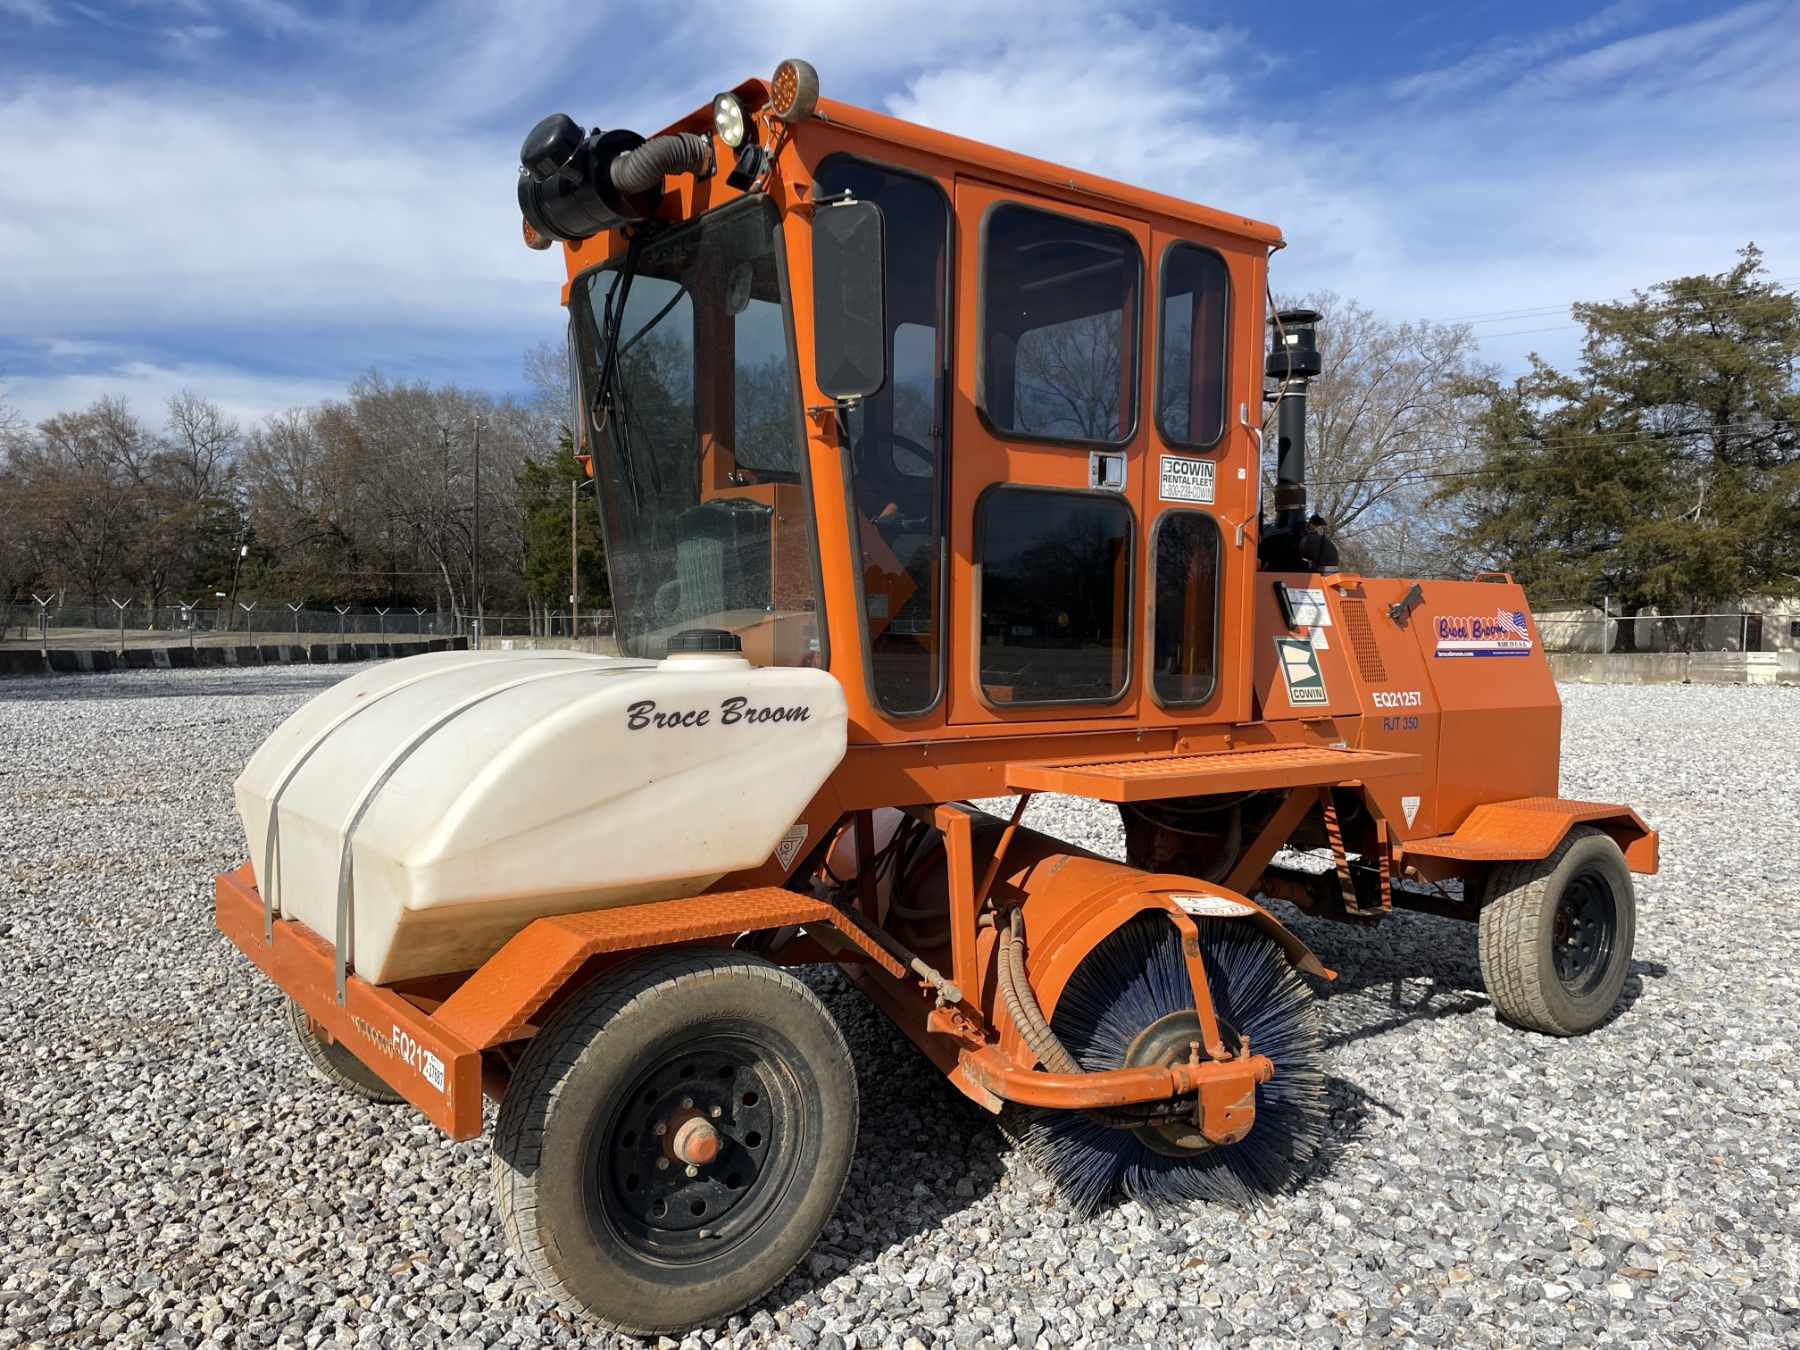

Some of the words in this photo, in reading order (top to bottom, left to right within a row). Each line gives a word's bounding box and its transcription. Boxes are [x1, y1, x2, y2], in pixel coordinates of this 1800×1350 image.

[1173, 461, 1213, 478] COWIN
[1162, 474, 1191, 485] RENTAL
[1192, 477, 1213, 487] FLEET
[1293, 688, 1323, 699] COWIN
[1372, 692, 1421, 708] EQ21257
[626, 700, 710, 731] Broce
[720, 696, 811, 725] Broom
[1383, 717, 1401, 731] RJT
[1403, 716, 1419, 730] 350
